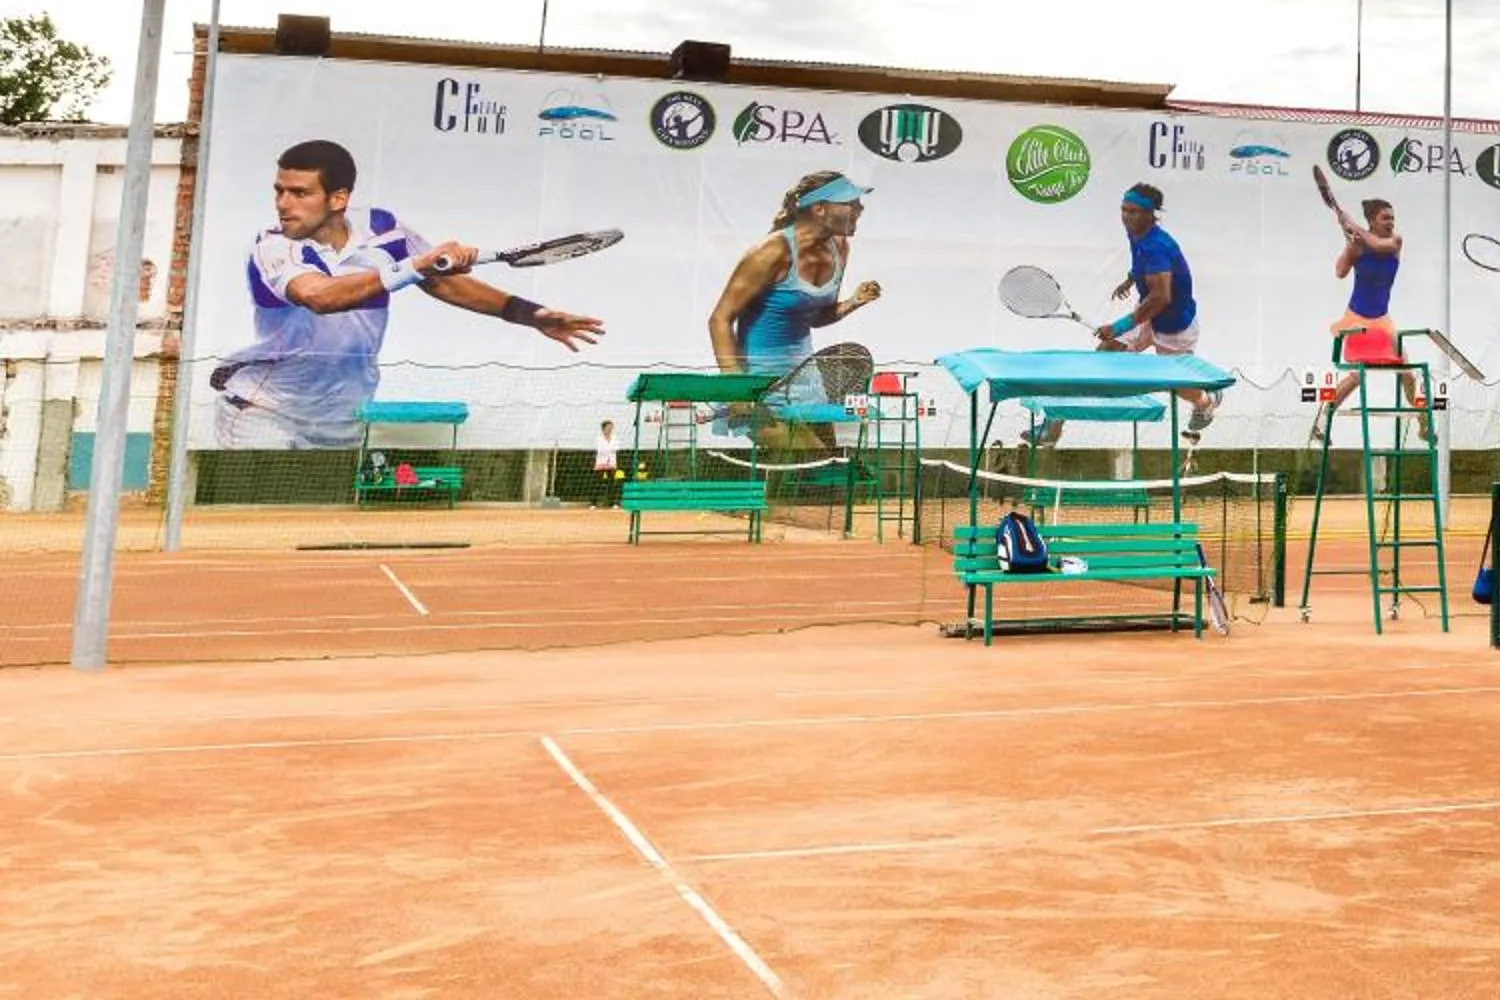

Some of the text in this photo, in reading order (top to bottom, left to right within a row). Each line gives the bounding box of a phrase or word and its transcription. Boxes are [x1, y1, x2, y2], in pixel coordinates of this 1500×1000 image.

[540, 127, 615, 141] POOL
[752, 105, 832, 145] SPA
[1404, 139, 1466, 176] SPA
